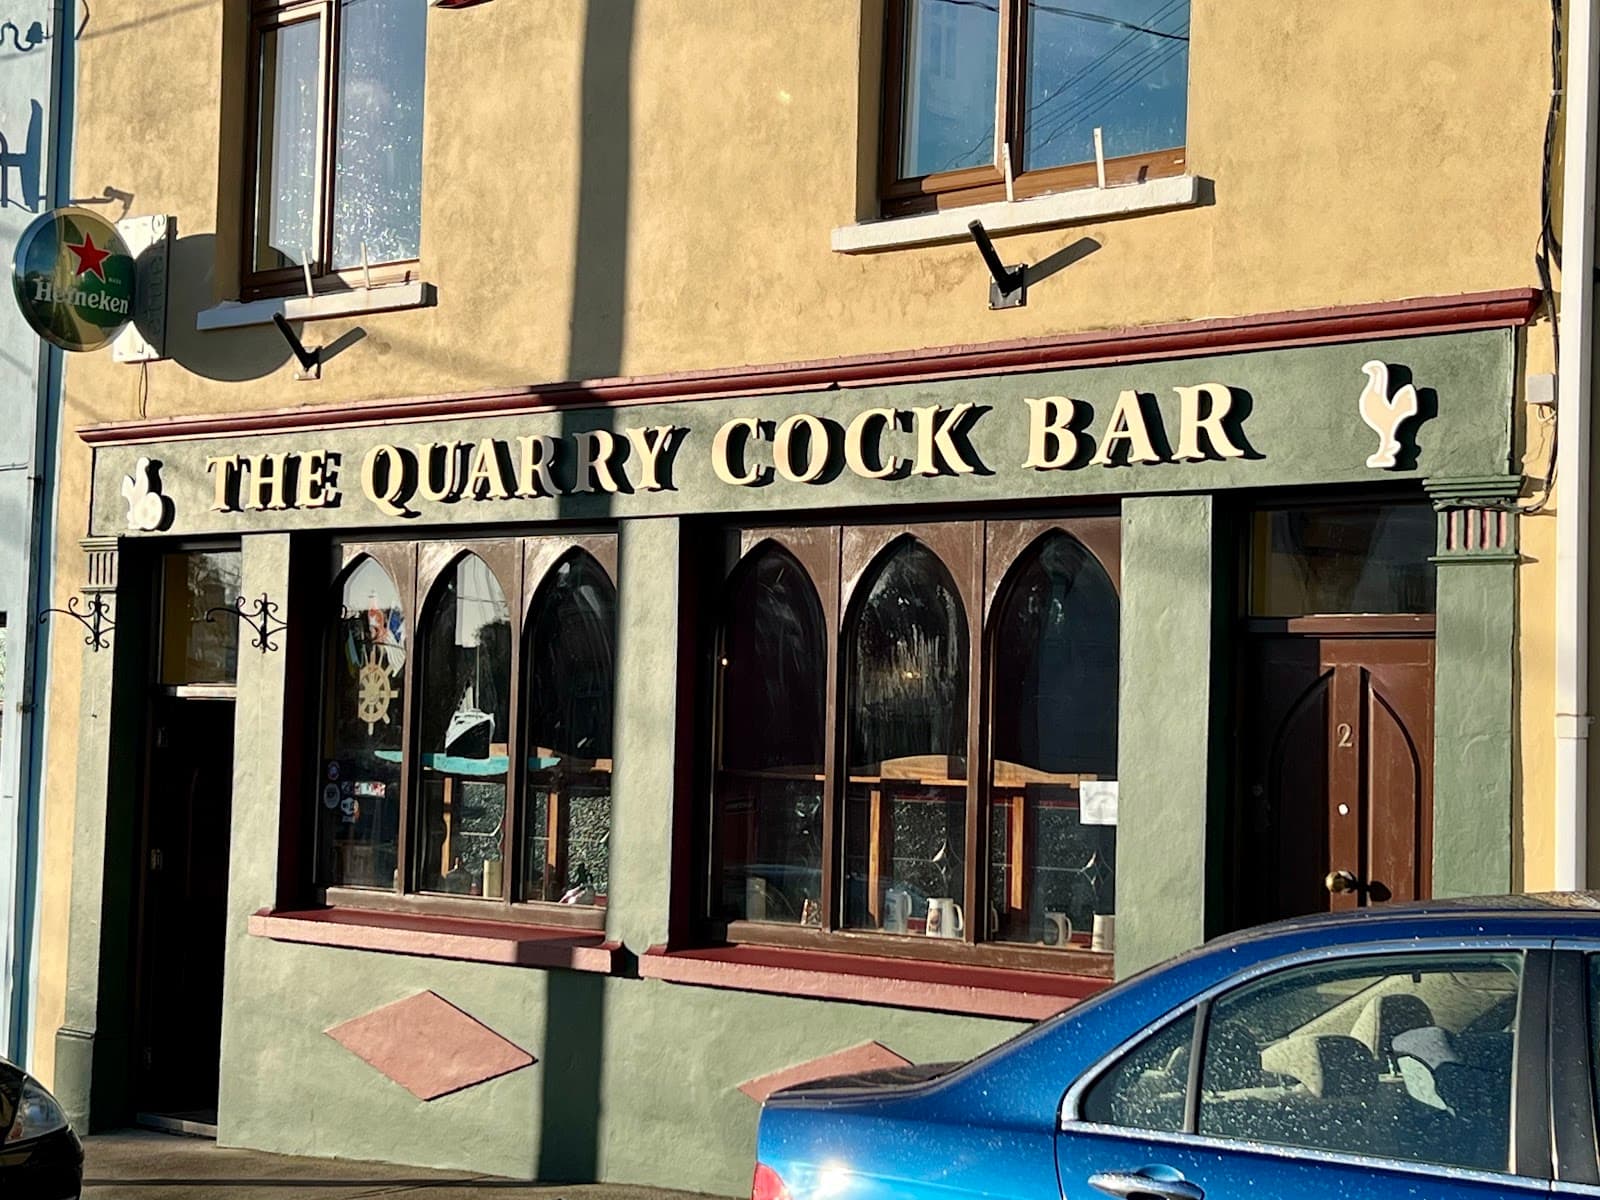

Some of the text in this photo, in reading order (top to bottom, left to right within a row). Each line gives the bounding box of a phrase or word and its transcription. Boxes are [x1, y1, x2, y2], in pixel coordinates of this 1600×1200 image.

[33, 275, 129, 314] Heineken
[206, 382, 1245, 516] THE QUARRY COCK BAR
[1336, 723, 1353, 748] 2
